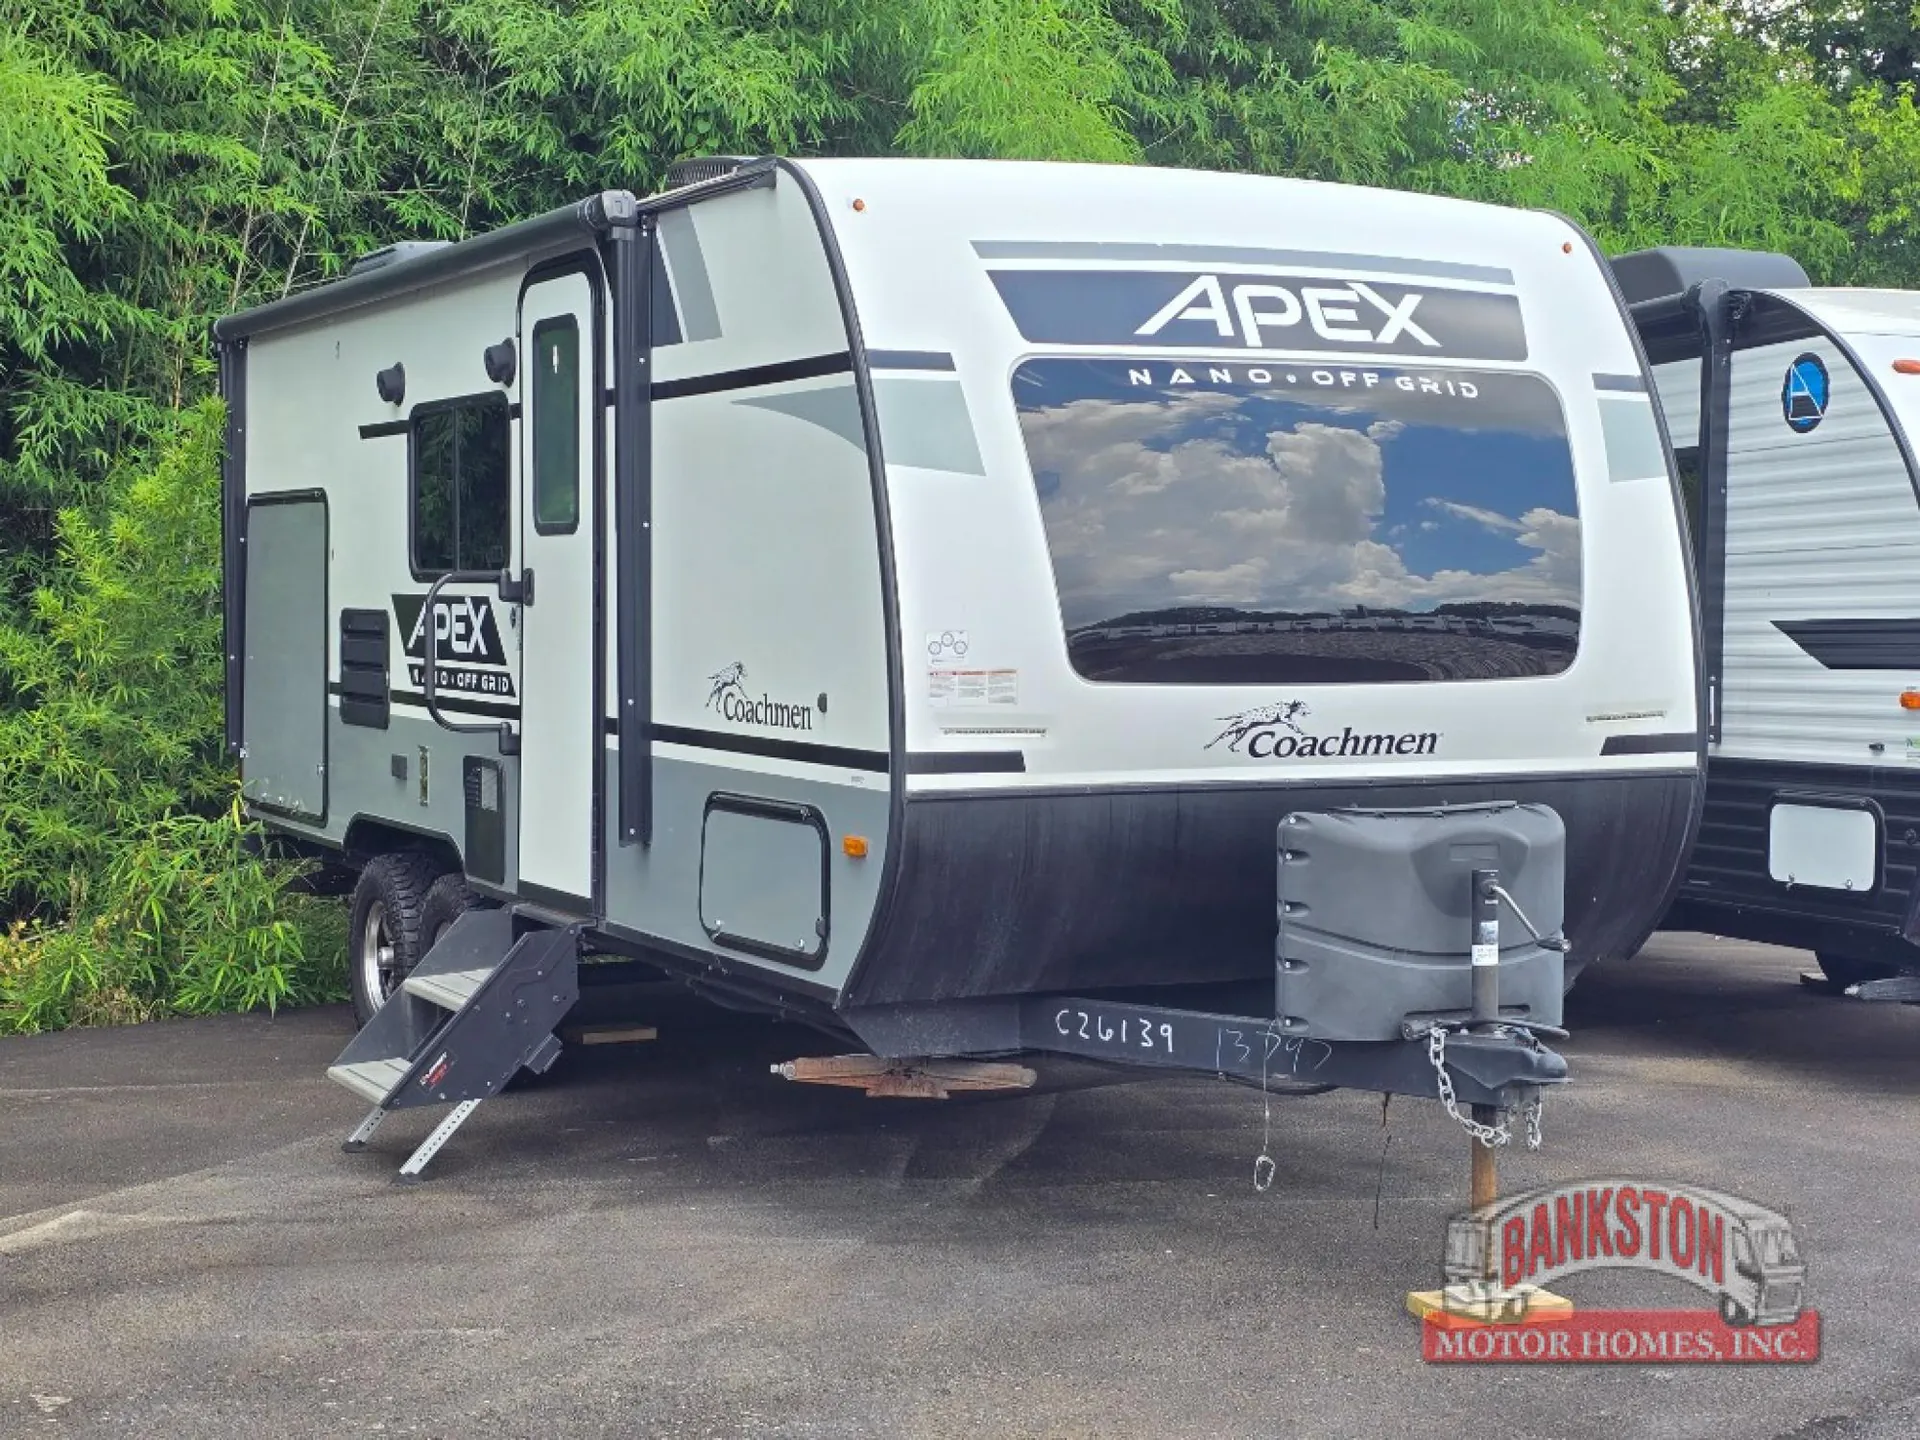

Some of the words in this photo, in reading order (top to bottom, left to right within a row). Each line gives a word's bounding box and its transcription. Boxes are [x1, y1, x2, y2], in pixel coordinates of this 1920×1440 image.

[1133, 275, 1442, 347] APEX
[1129, 369, 1272, 386] NANO
[1312, 370, 1380, 388] OFF
[1395, 376, 1479, 398] GRID
[456, 672, 479, 690] OFF
[481, 674, 509, 693] GRID
[723, 691, 813, 730] Coachmen
[1248, 727, 1438, 758] Coachmen
[1054, 1008, 1174, 1053] C26139
